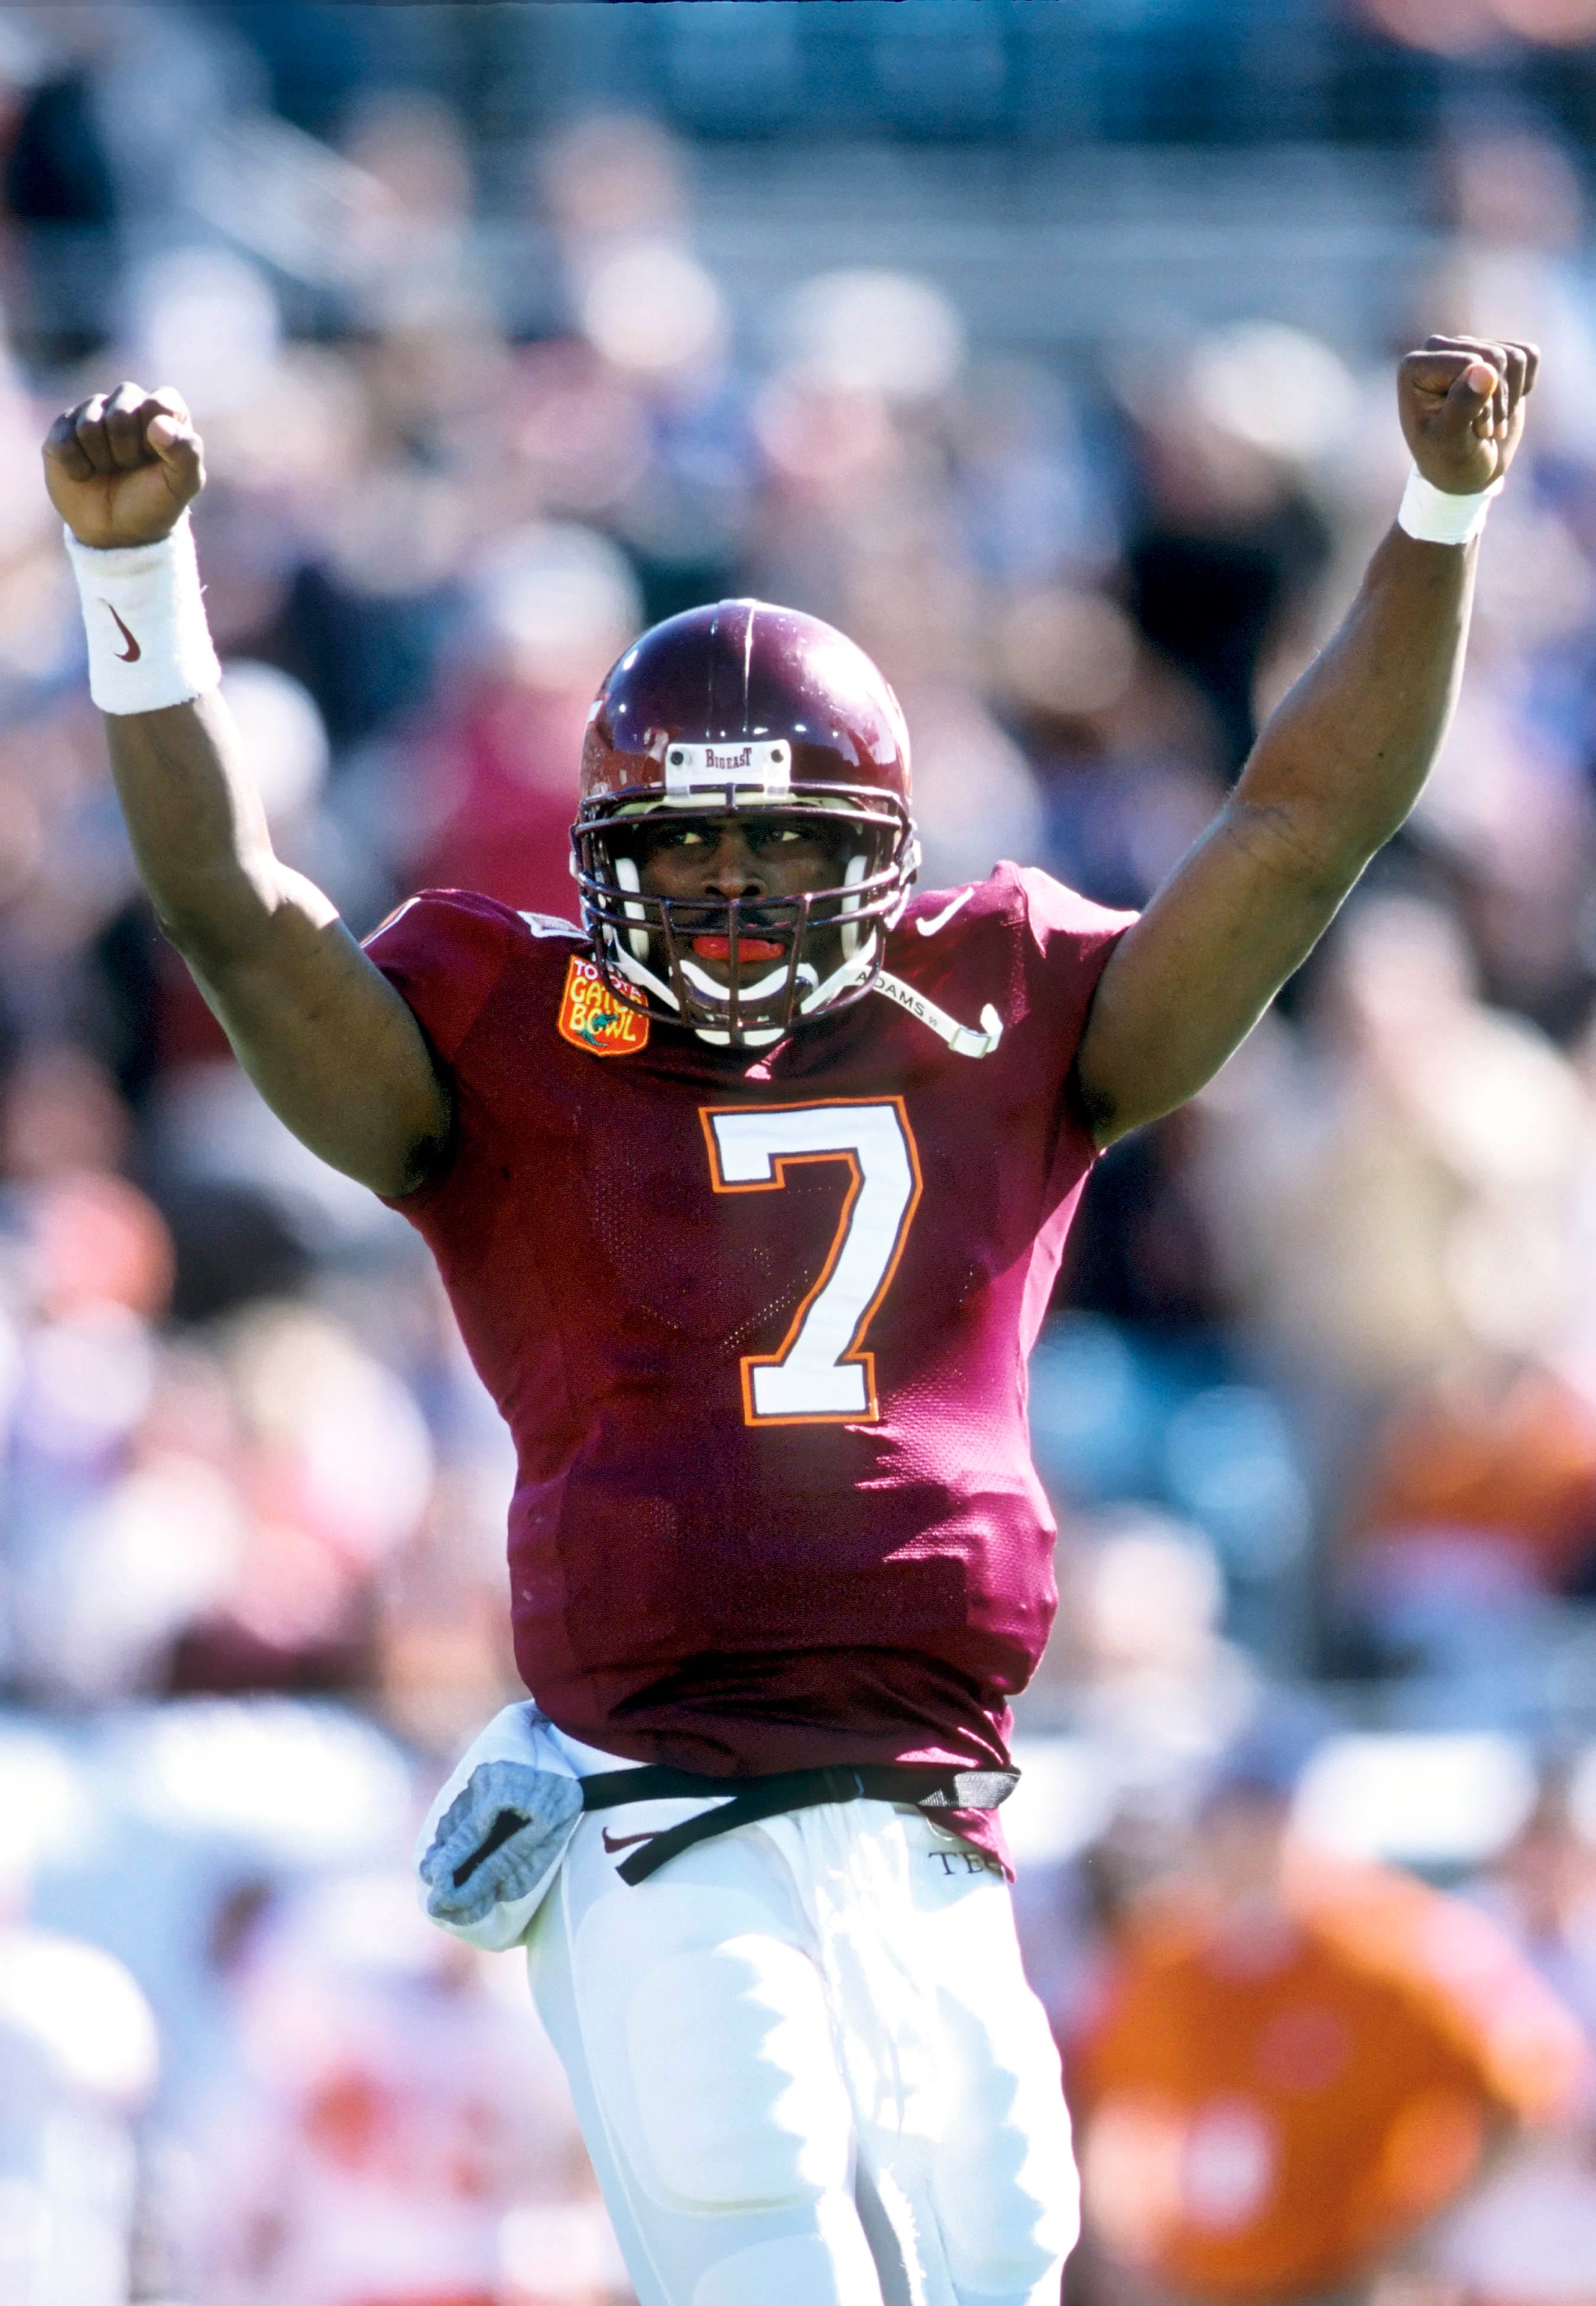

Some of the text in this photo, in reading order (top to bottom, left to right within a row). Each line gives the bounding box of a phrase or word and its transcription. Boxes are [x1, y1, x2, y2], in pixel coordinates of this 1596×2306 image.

[574, 959, 642, 998] TOOTA
[855, 971, 925, 1016] ADAMS
[569, 1002, 636, 1041] BOWL
[698, 1094, 923, 1427] 7
